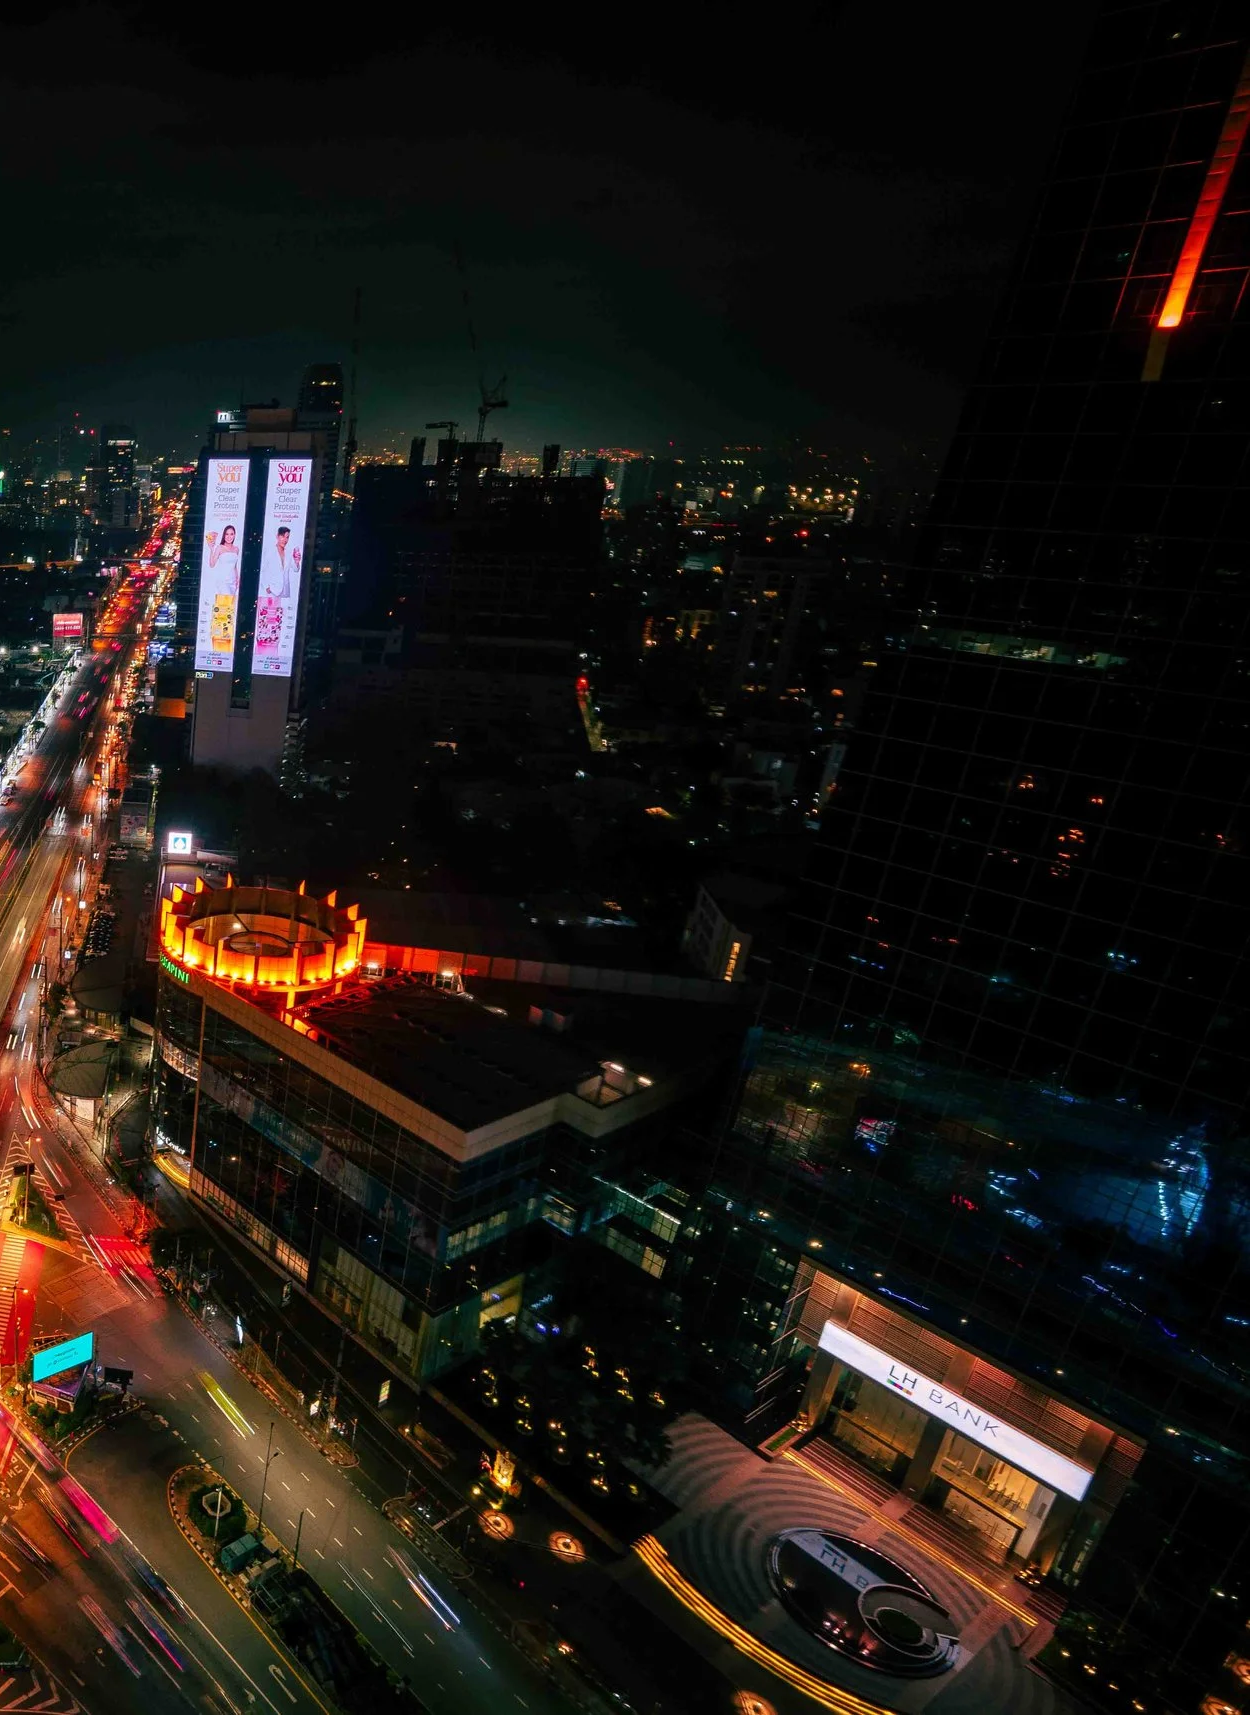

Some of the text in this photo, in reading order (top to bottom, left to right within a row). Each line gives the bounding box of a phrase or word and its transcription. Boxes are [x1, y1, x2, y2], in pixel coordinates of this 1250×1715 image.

[217, 463, 244, 473] Super
[278, 462, 306, 473] Super
[218, 494, 236, 502] Clear
[278, 495, 298, 503] Clear
[213, 502, 239, 510] Protein
[273, 503, 301, 511] Protein
[889, 1365, 1000, 1438] LH BANK
